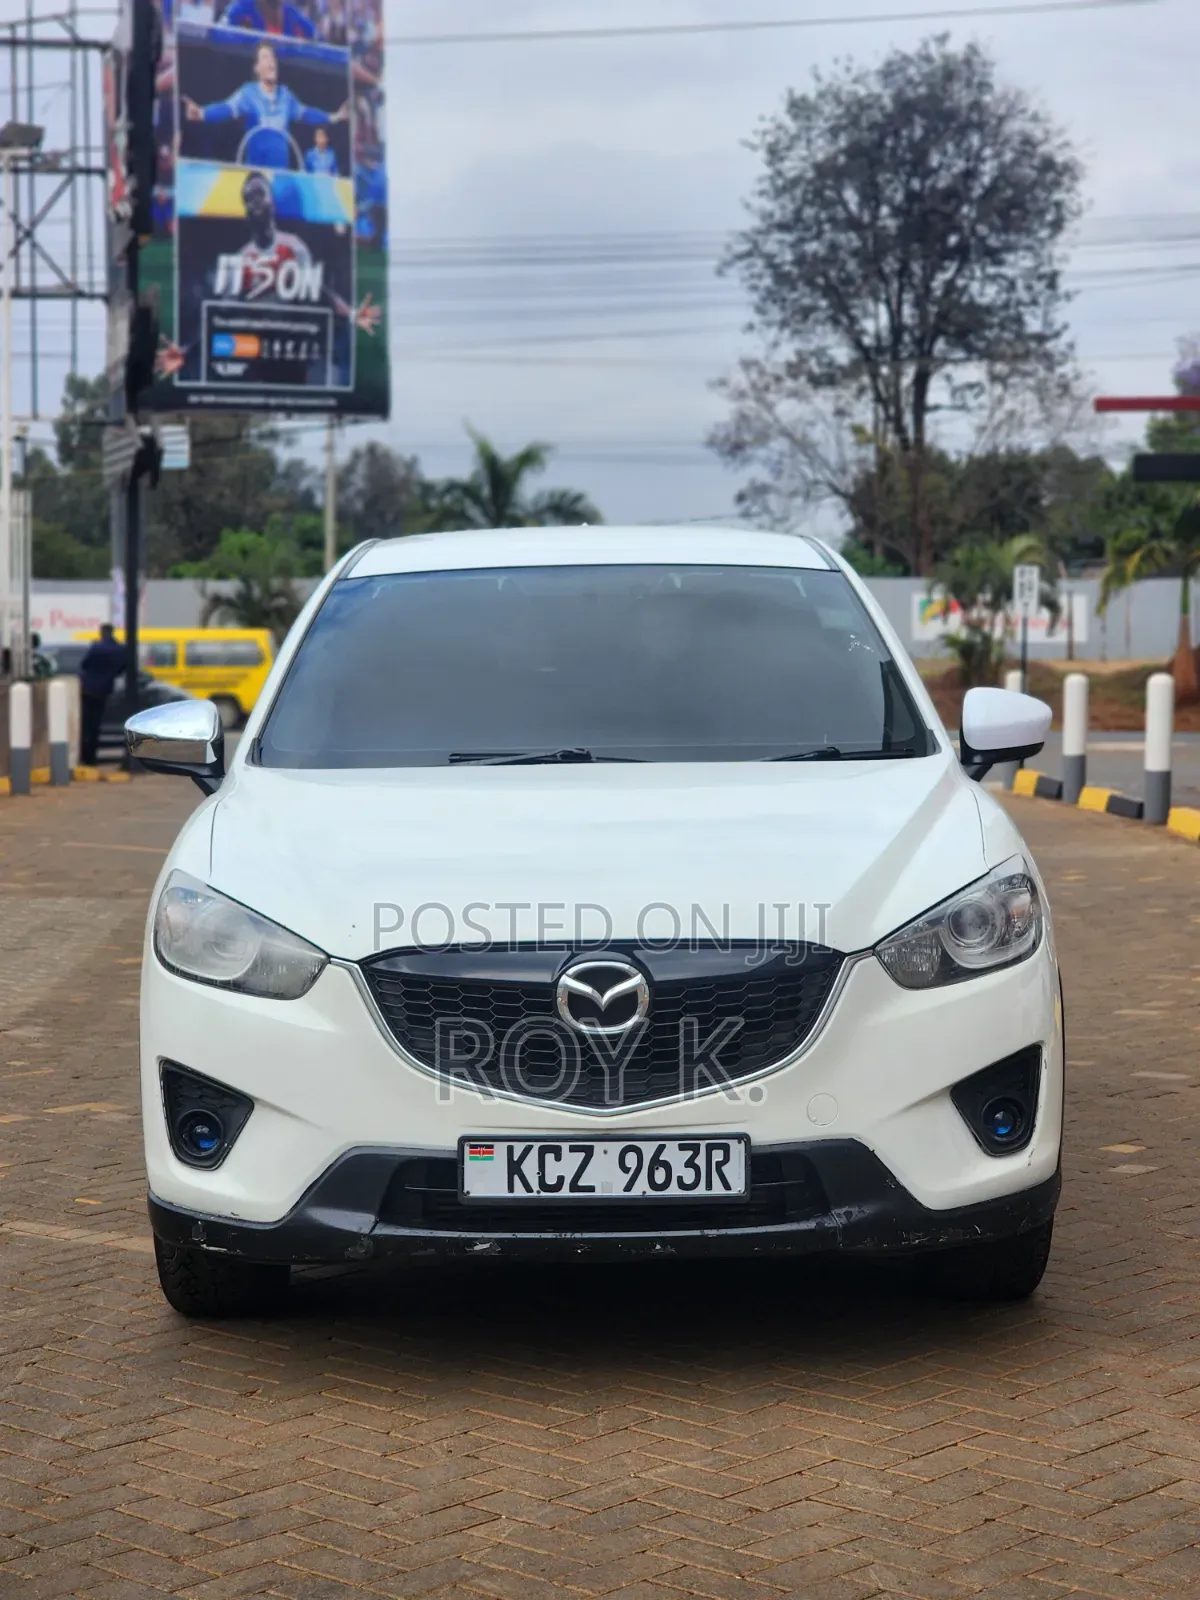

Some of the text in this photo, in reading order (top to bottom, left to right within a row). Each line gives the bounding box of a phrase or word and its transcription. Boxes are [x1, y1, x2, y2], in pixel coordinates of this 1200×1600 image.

[276, 259, 324, 302] ON
[506, 1144, 596, 1194] KCZ
[617, 1142, 733, 1193] 963R
